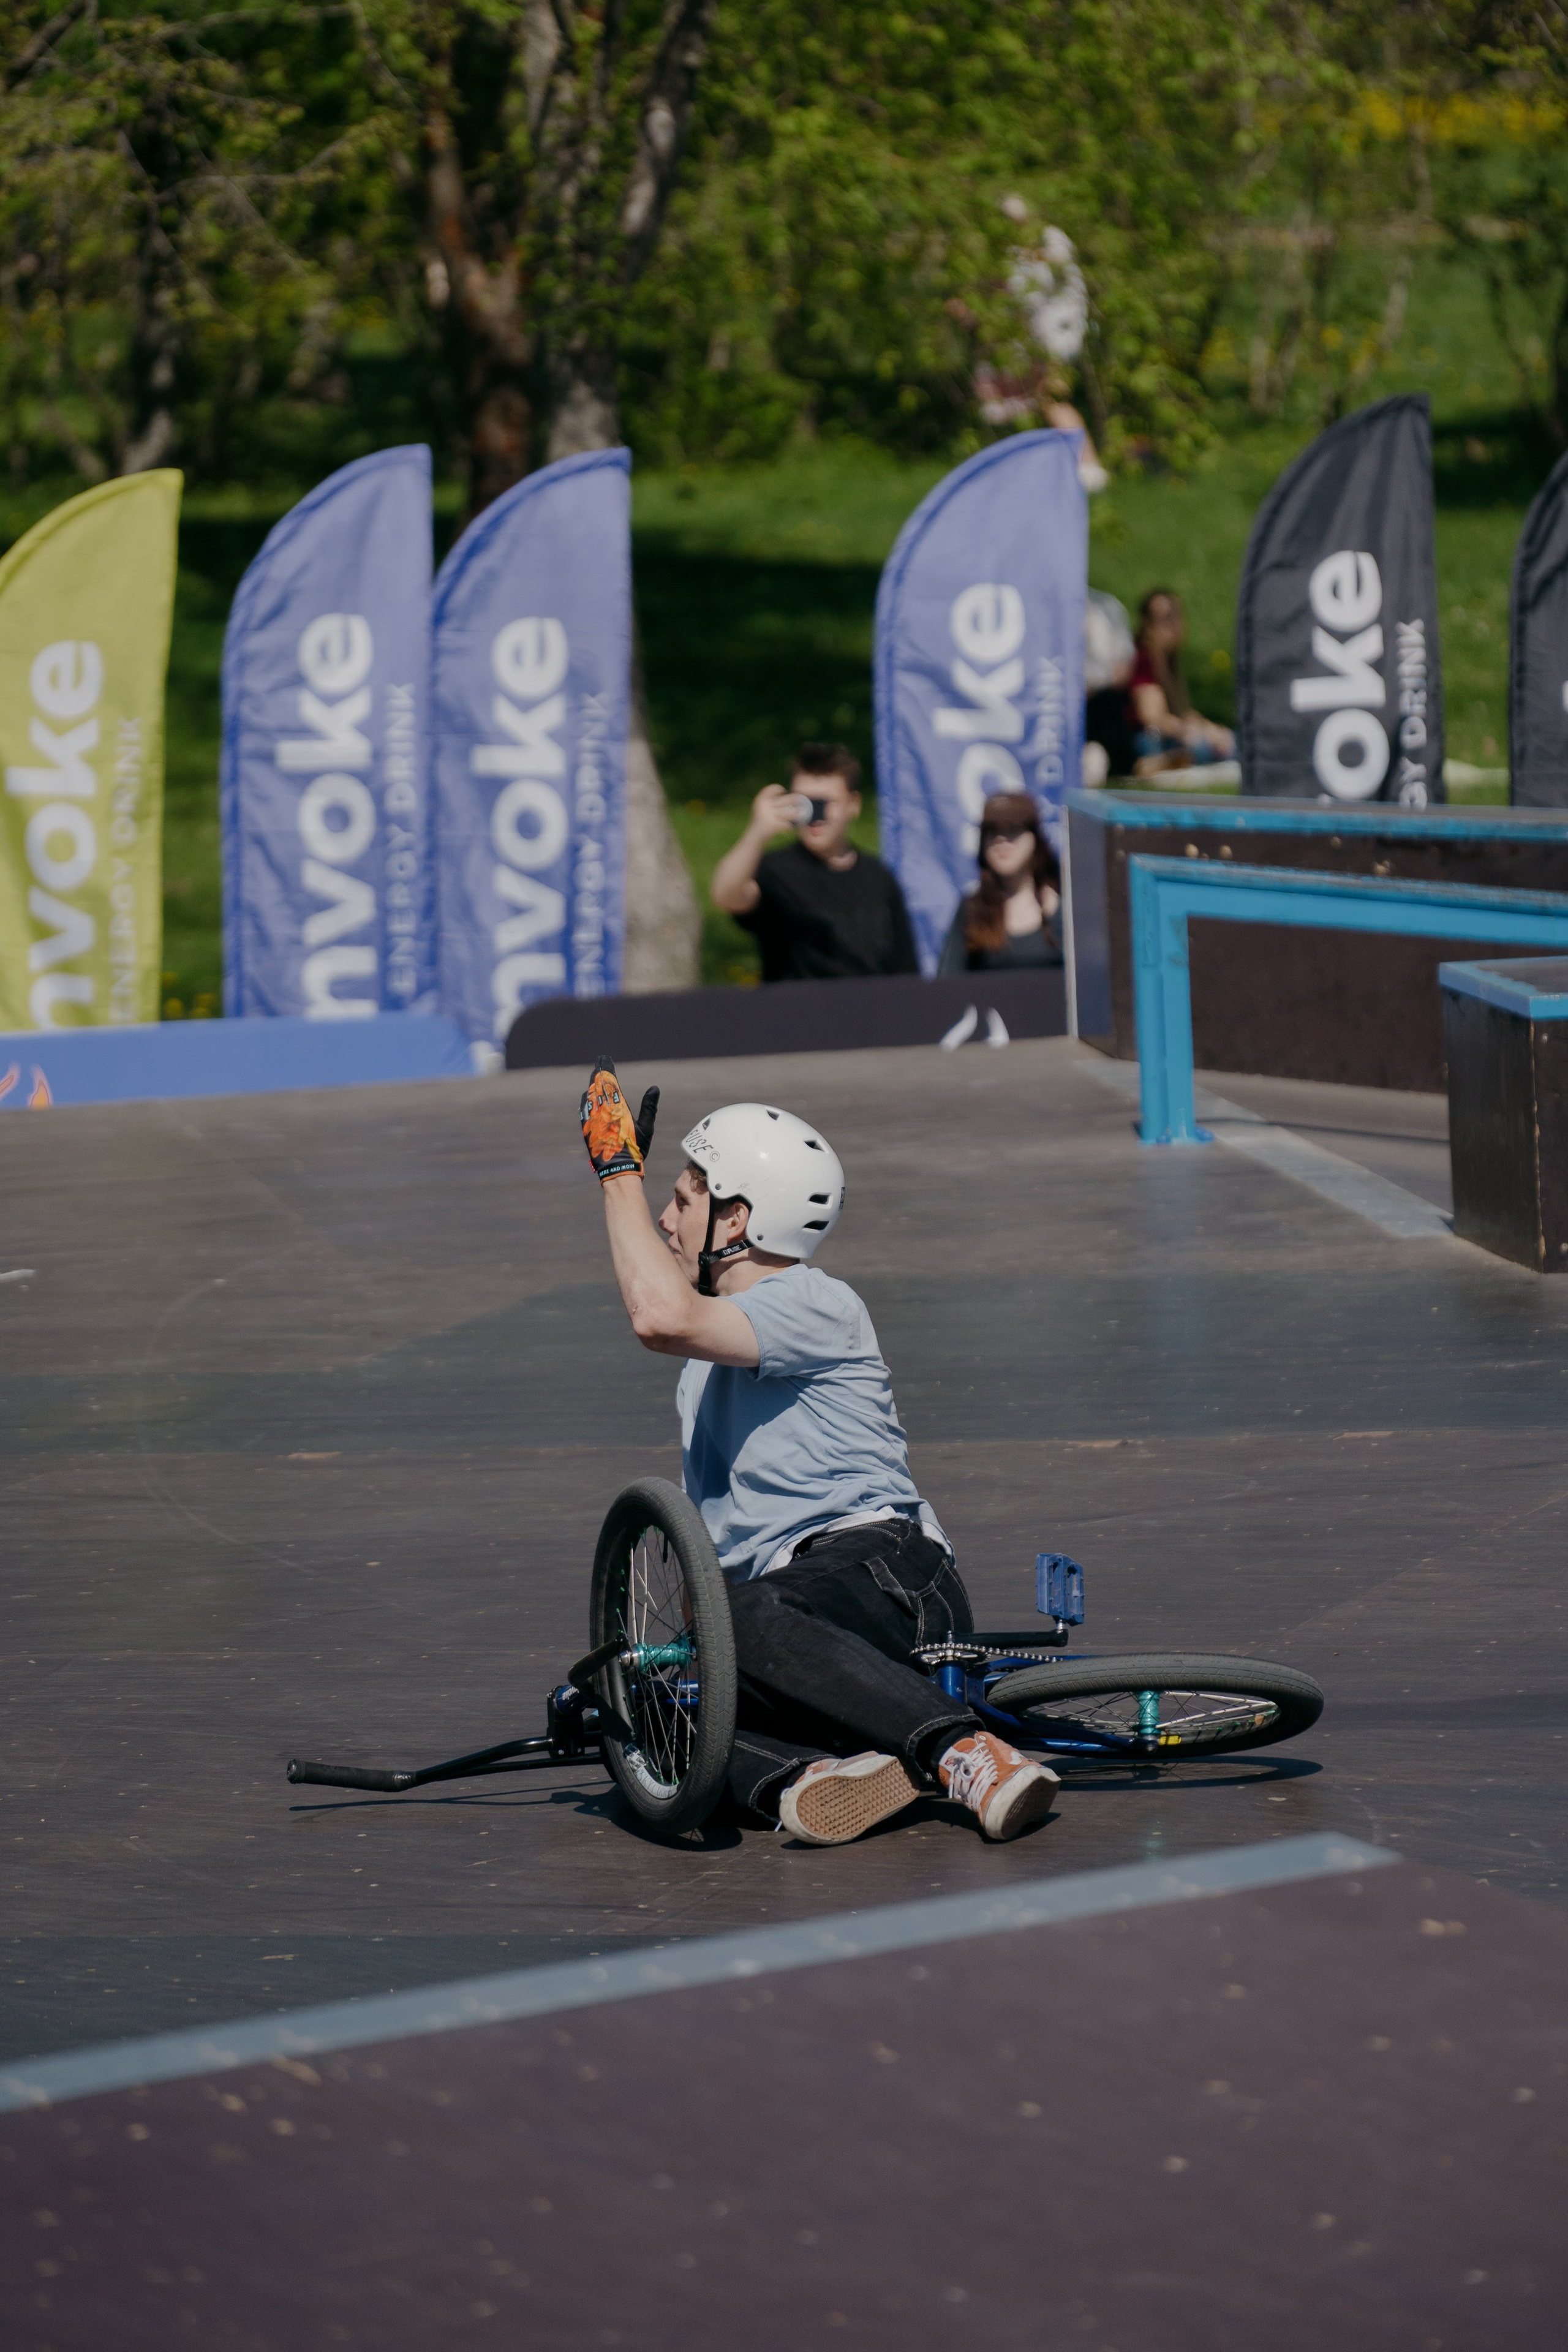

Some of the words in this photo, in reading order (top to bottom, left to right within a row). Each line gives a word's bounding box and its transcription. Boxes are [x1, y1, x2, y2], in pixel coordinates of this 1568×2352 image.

[932, 582, 1025, 882] oke
[1289, 550, 1390, 807] oke
[1395, 617, 1428, 750] DRINK
[111, 717, 142, 845] DRINK
[384, 682, 416, 815] DRINK
[575, 692, 609, 821] DRINK
[470, 616, 568, 1066] nvoke
[386, 826, 418, 995] ENERGY
[726, 1245, 742, 1254] FUSE
